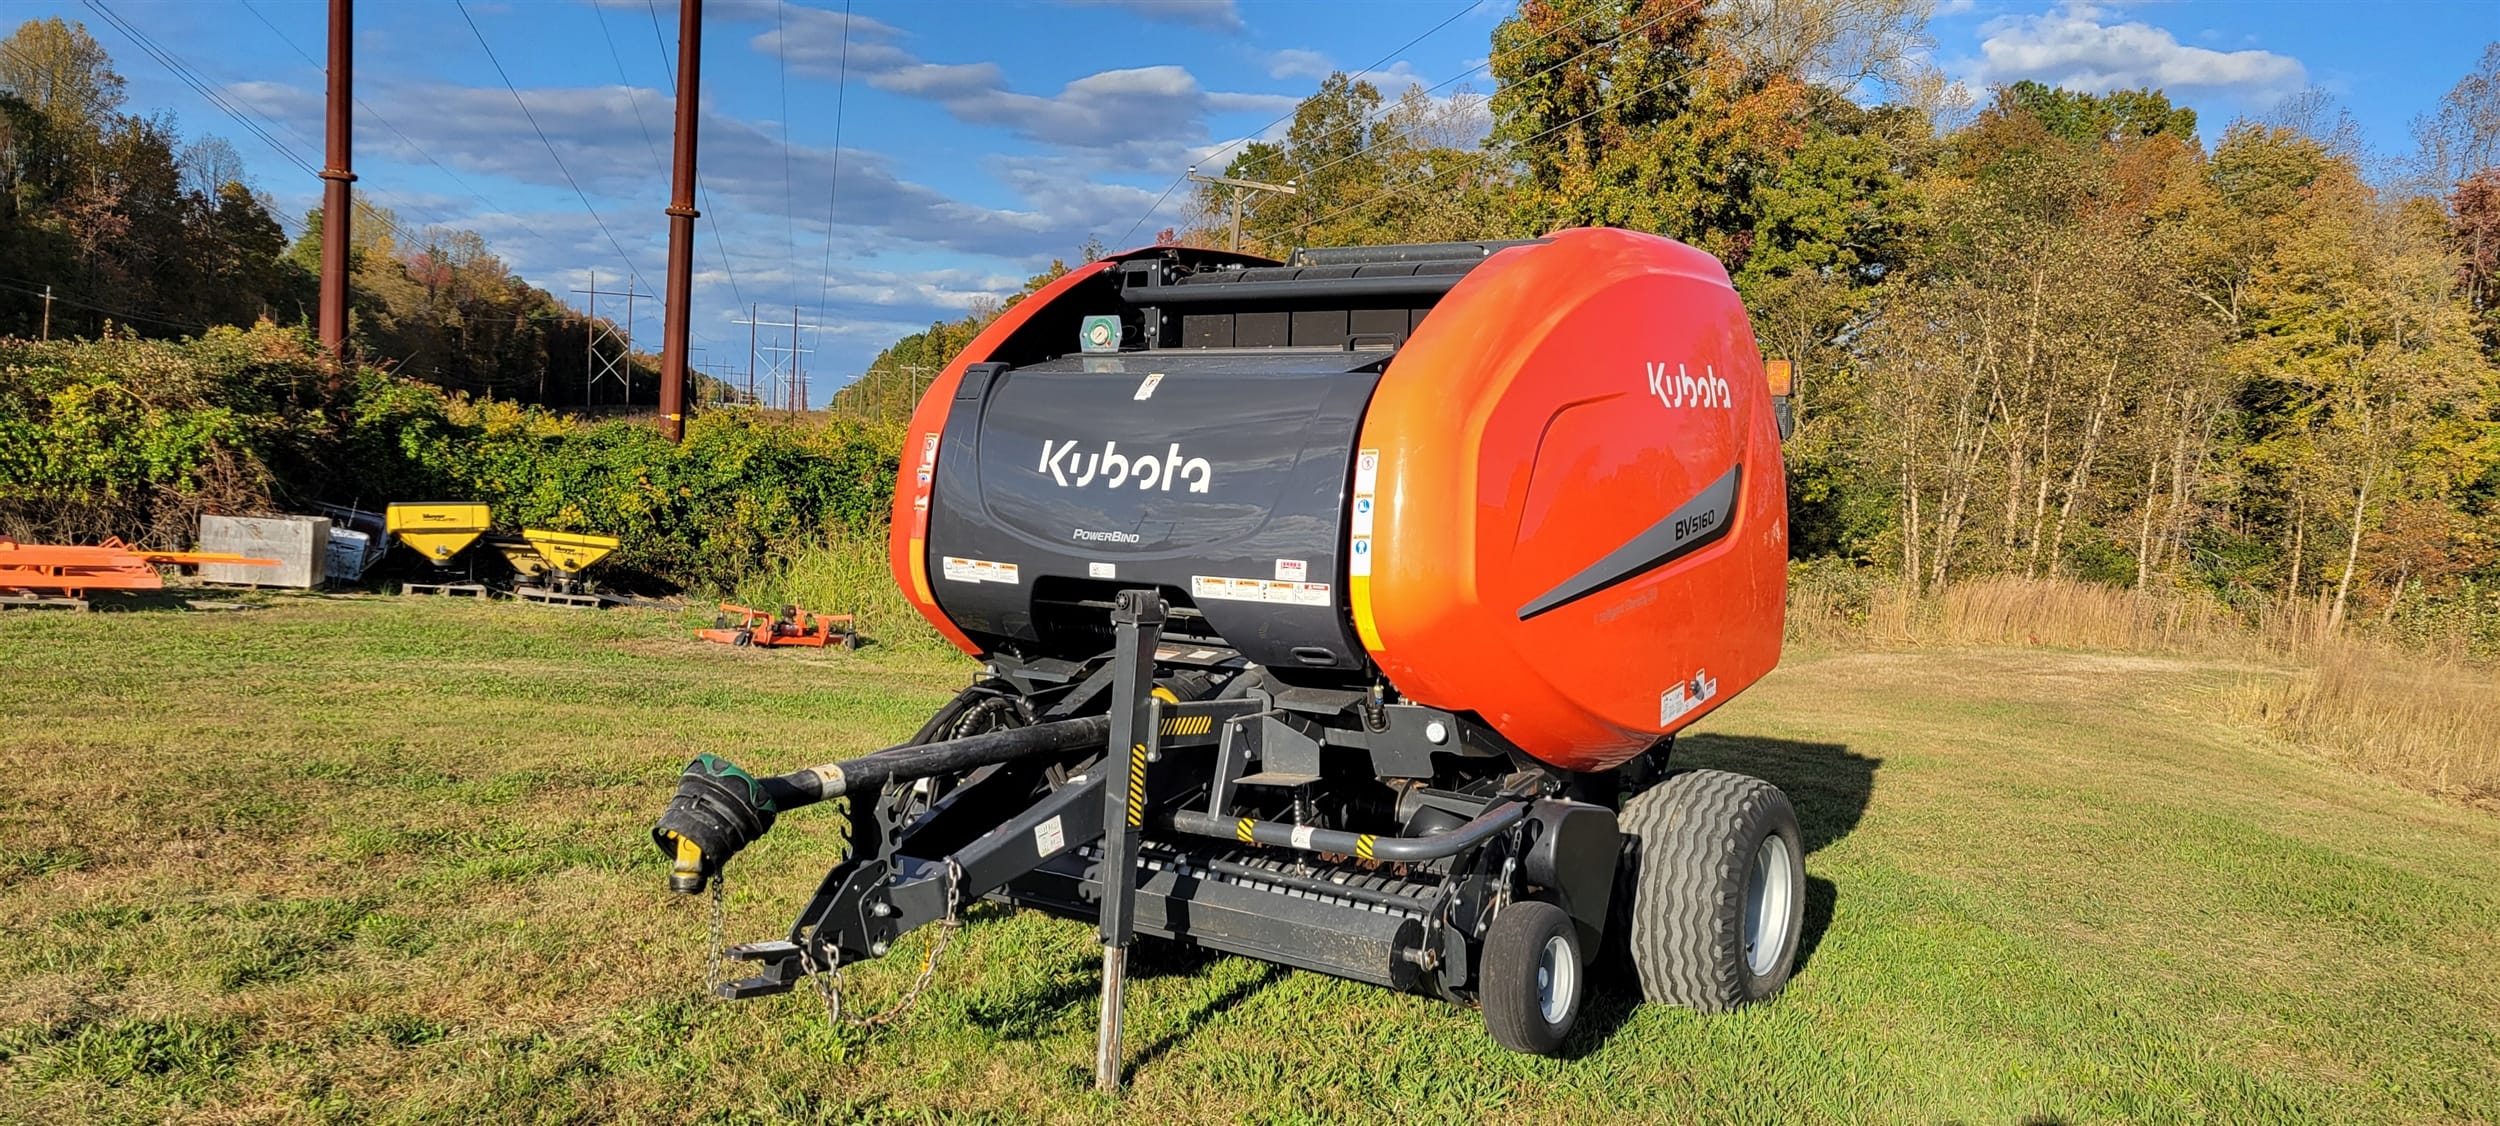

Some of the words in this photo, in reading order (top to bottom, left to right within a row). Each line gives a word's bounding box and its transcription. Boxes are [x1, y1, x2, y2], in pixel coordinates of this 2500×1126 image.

[1647, 361, 1731, 409] Kubota
[1038, 439, 1212, 493] Kubota
[1675, 509, 1715, 541] BV5160
